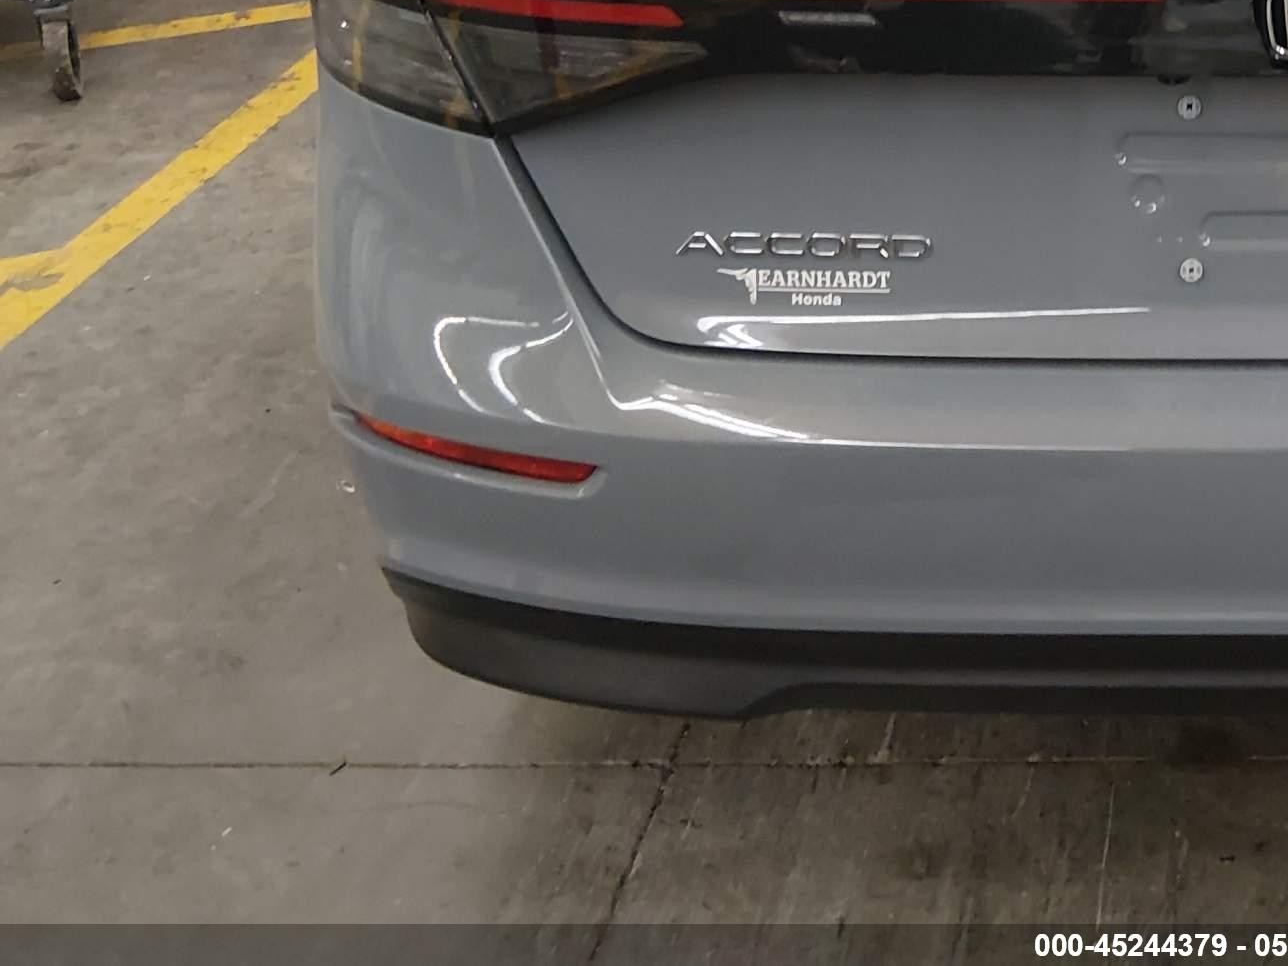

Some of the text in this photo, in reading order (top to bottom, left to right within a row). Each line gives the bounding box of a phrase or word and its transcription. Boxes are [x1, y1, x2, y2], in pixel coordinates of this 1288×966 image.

[675, 230, 935, 259] ACCORD
[756, 268, 891, 289] EARNHARDT
[791, 292, 842, 307] Honda
